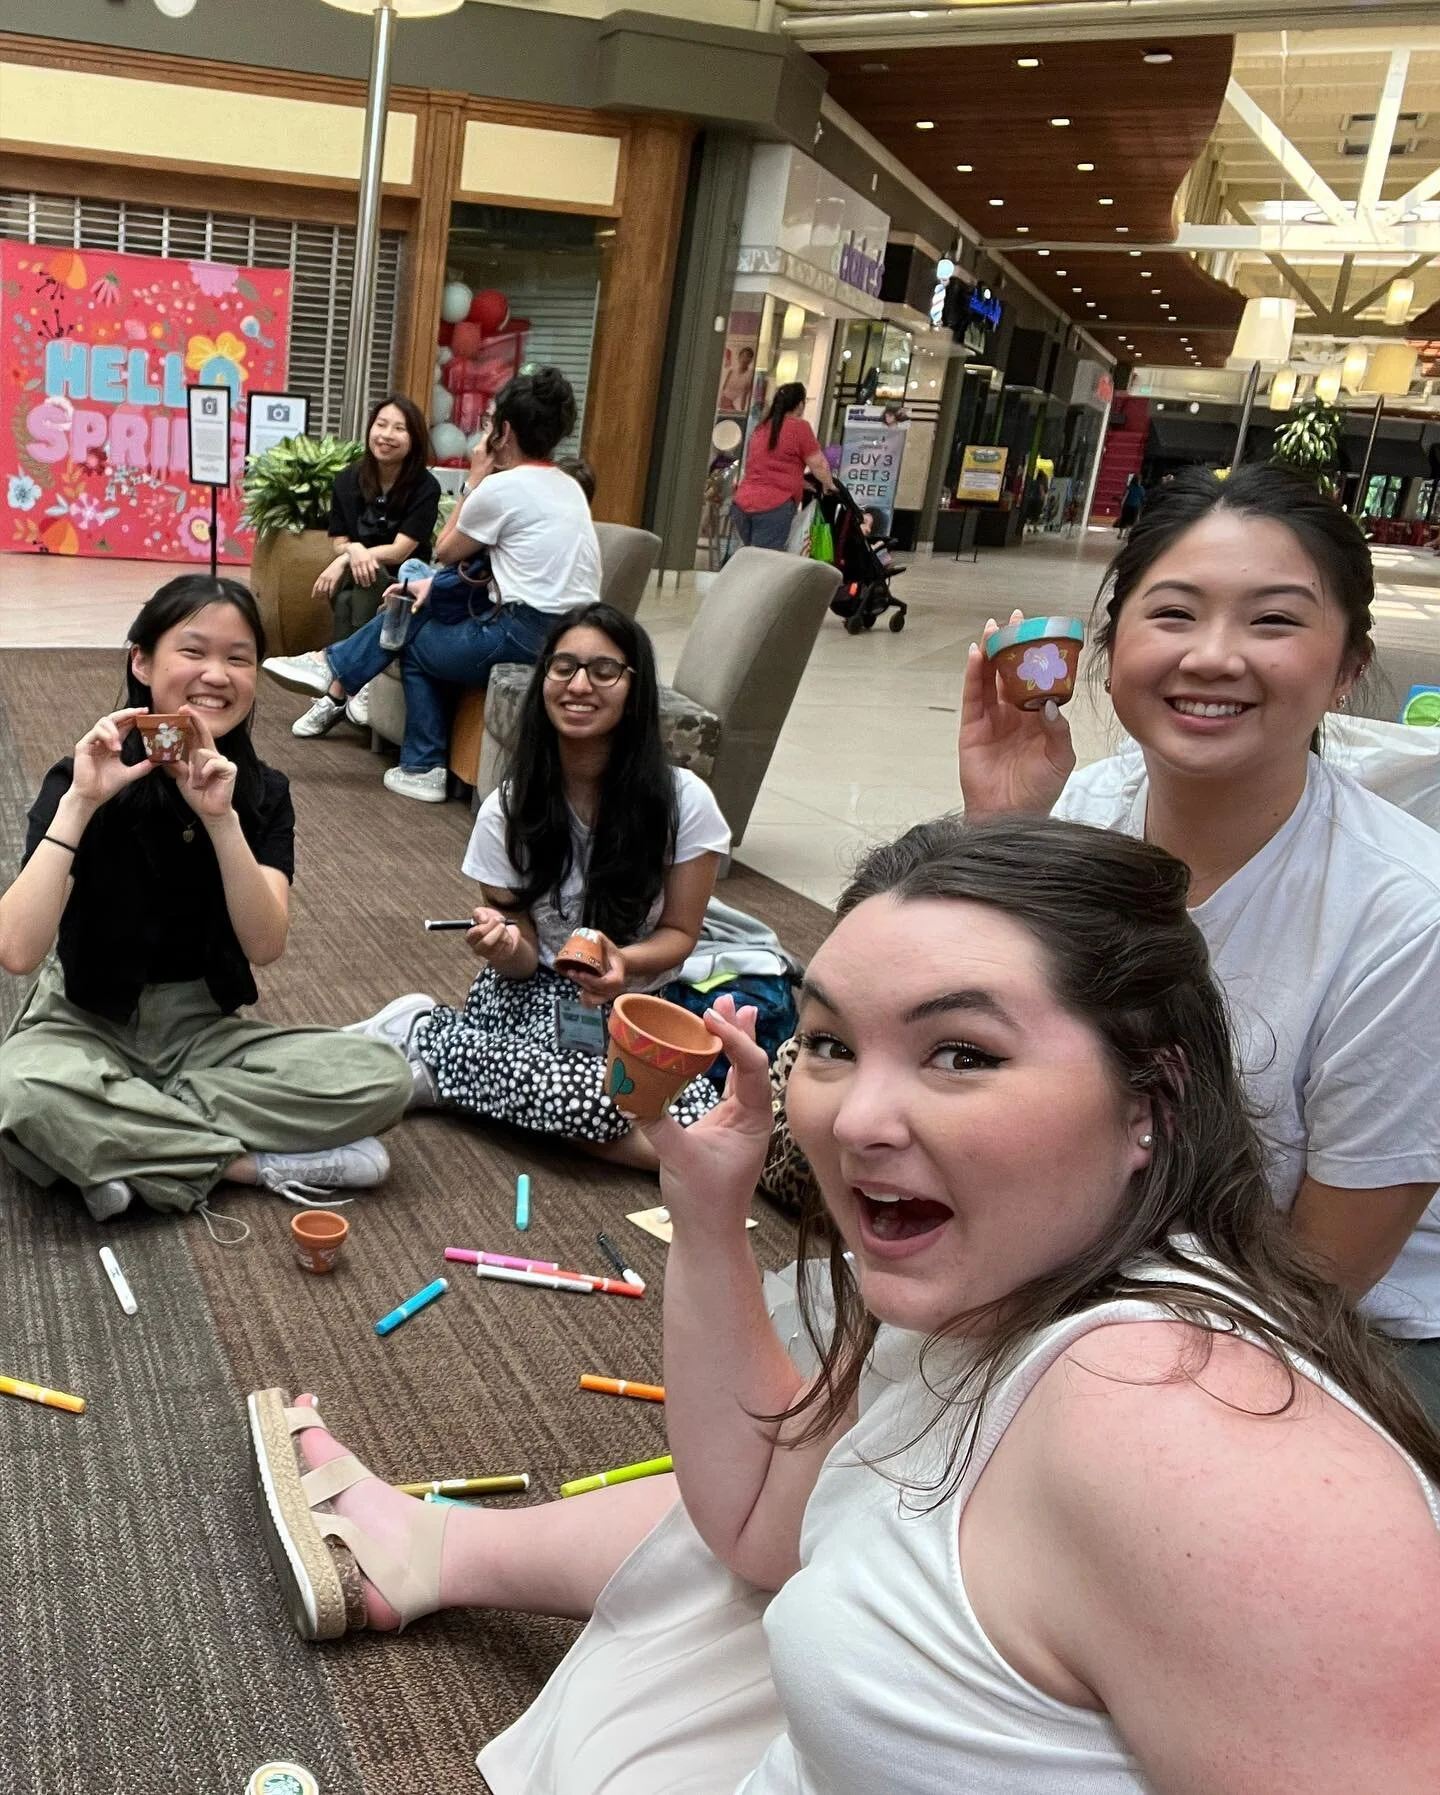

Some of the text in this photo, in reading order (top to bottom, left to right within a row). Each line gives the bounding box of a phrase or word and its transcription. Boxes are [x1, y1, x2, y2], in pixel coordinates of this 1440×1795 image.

[46, 340, 242, 409] HELLO
[850, 452, 893, 467] BUY 3
[848, 468, 890, 482] GET 3
[846, 483, 887, 497] FREE
